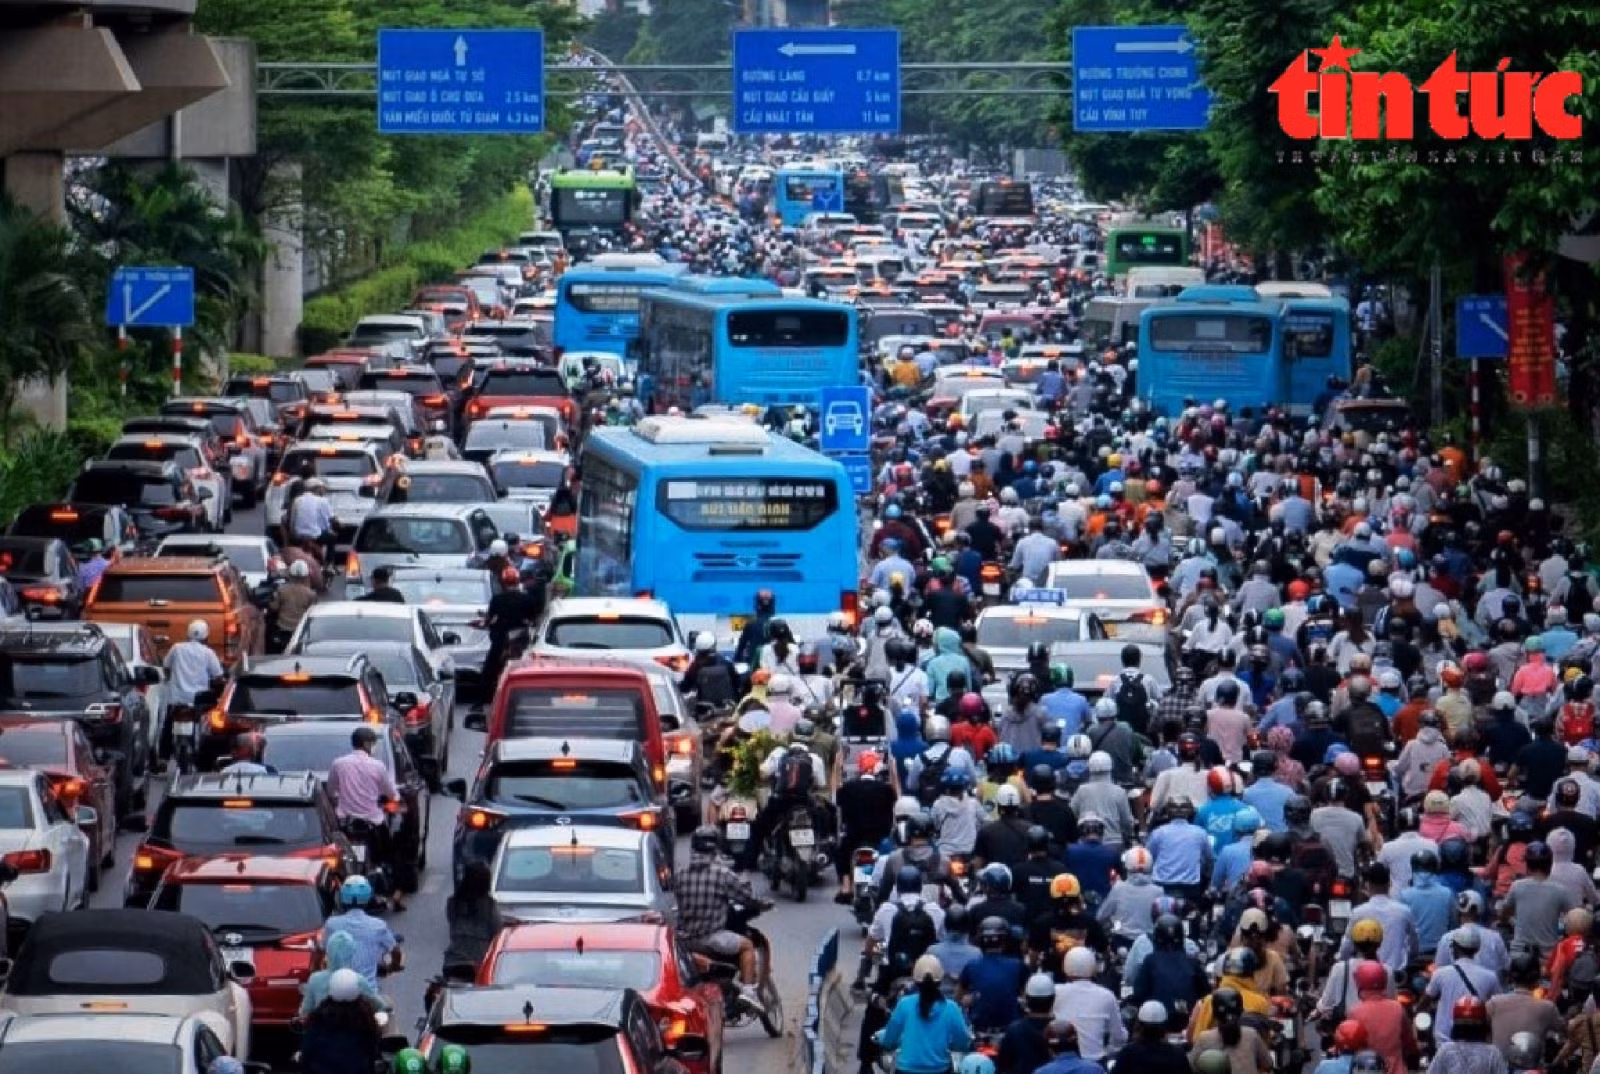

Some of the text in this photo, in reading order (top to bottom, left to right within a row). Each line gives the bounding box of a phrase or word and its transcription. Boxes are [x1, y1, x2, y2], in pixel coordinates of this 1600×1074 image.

[874, 70, 890, 81] km
[523, 90, 539, 103] km
[874, 90, 890, 103] km
[523, 111, 539, 123] km
[862, 110, 872, 123] 11
[874, 110, 890, 123] km
